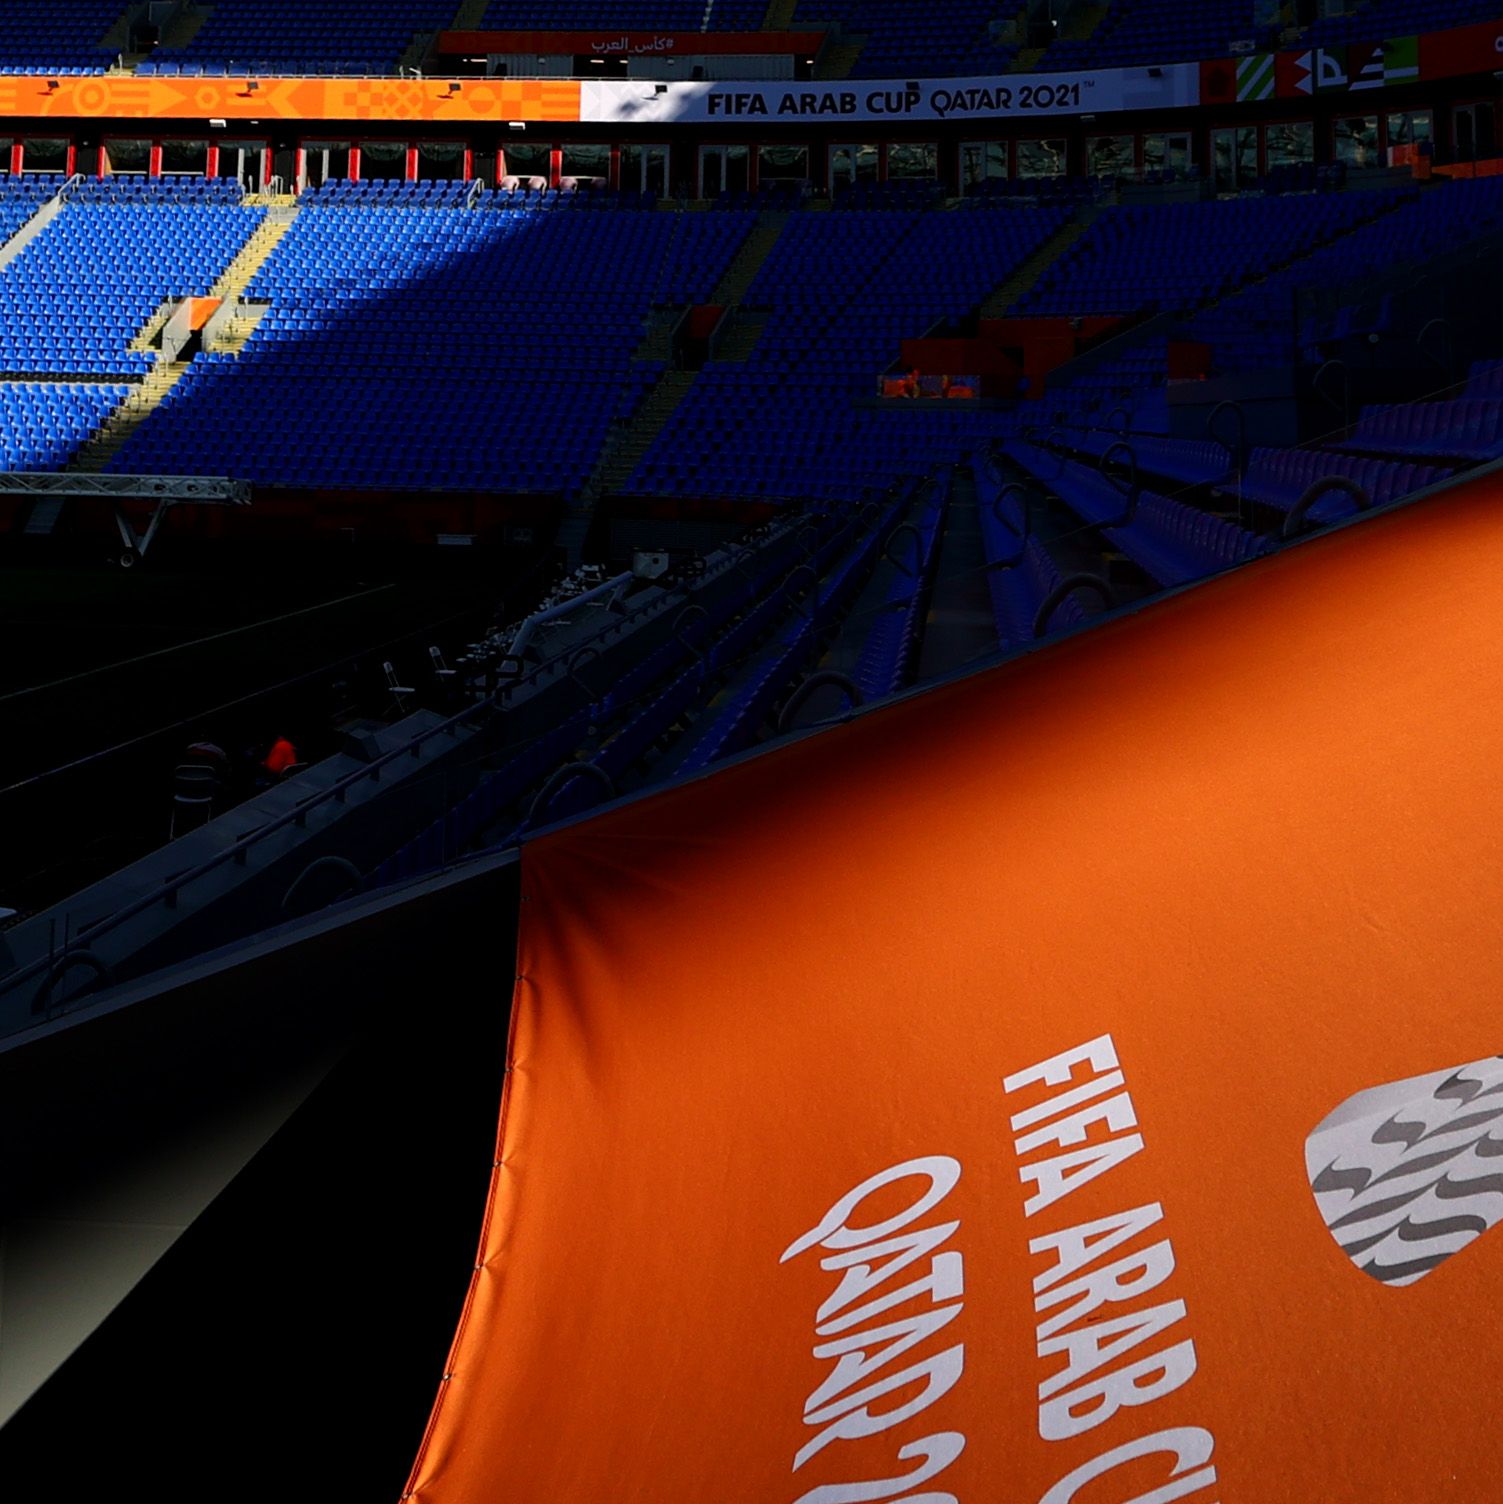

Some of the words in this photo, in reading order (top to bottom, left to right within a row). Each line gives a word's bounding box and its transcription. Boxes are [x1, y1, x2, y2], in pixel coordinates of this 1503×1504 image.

[708, 93, 767, 115] FIFA
[778, 93, 857, 114] ARAB
[866, 91, 921, 113] CUP
[930, 86, 1012, 117] QATAR
[1019, 83, 1080, 108] 2021
[1003, 1033, 1145, 1218] FIFA
[779, 1155, 965, 1474] QATAR
[1028, 1201, 1198, 1442] ARAB
